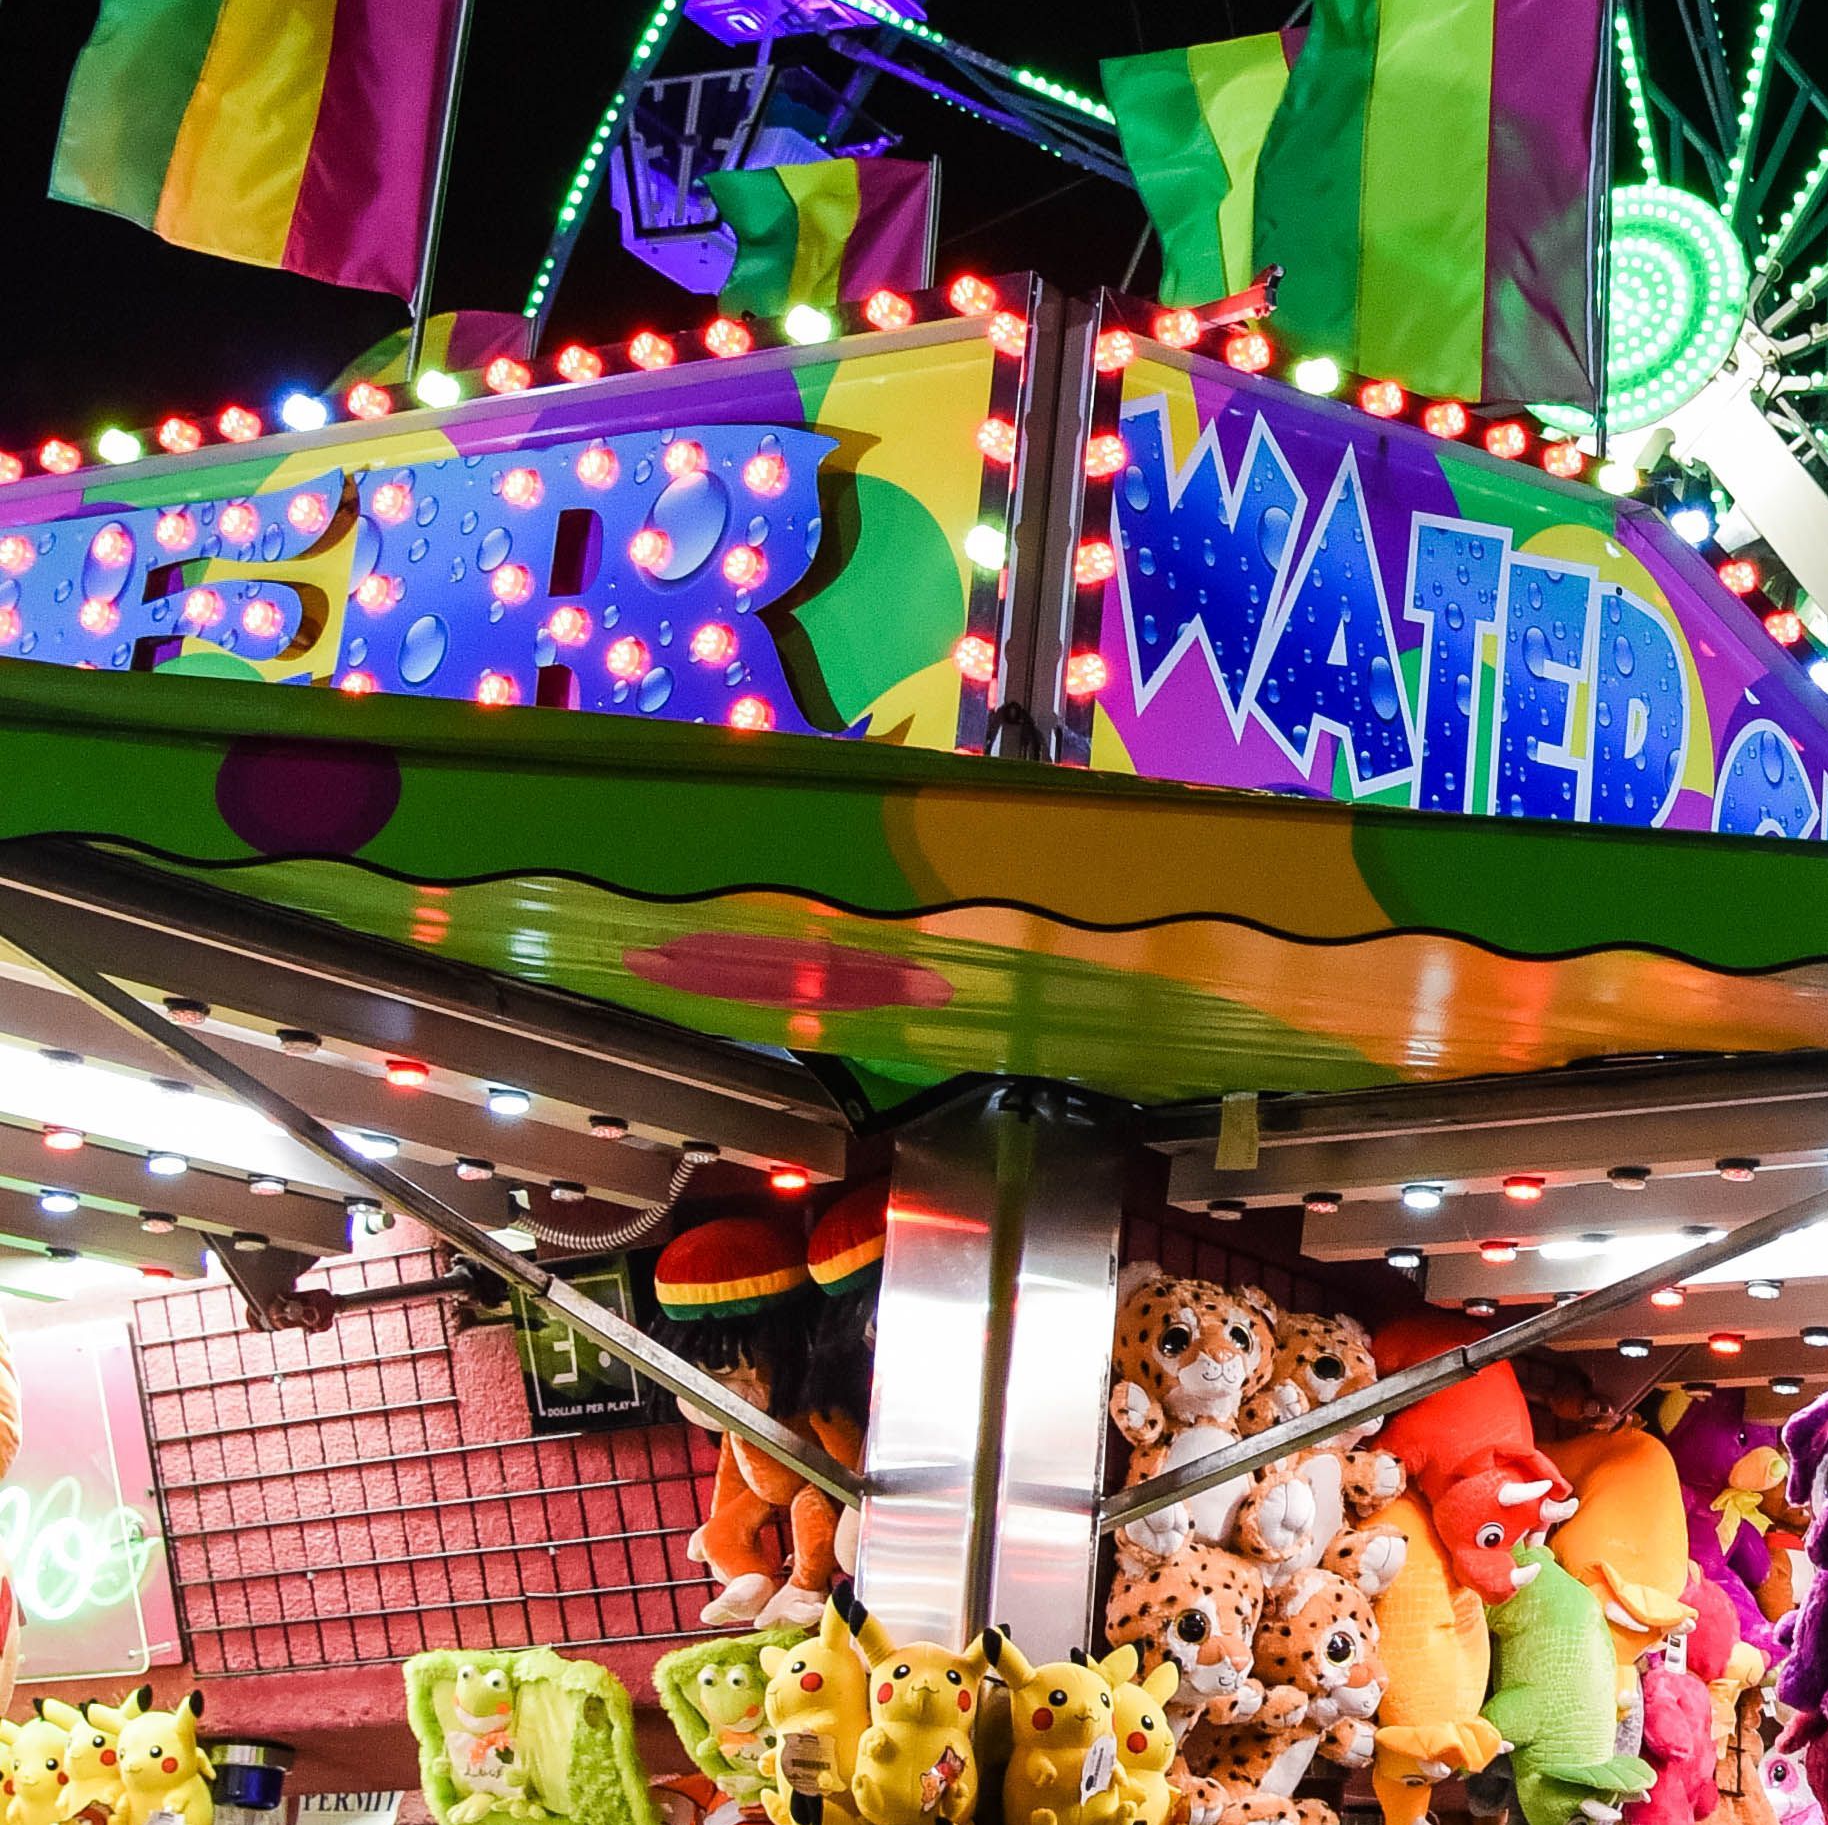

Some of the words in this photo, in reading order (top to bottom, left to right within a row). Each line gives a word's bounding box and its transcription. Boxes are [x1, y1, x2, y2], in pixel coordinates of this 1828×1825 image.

[547, 1404, 583, 1418] DOLLAR
[585, 1402, 605, 1413] PER
[607, 1400, 631, 1412] PLAY
[303, 1790, 397, 1813] PERMIT
